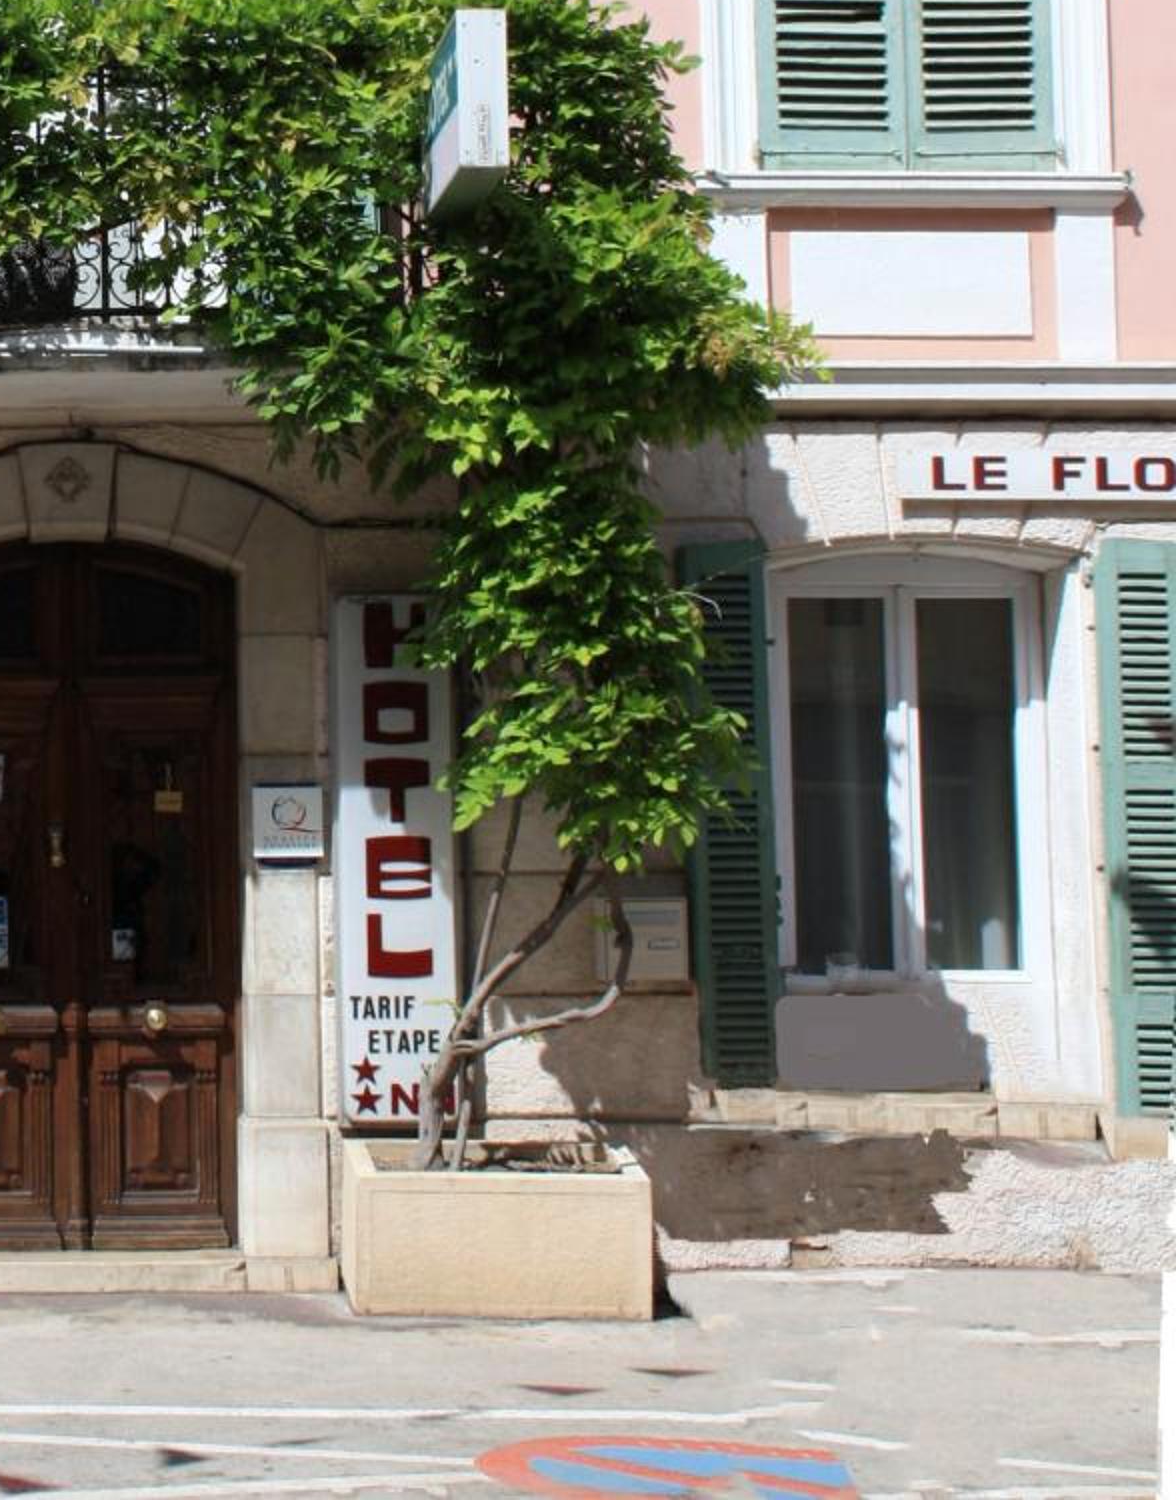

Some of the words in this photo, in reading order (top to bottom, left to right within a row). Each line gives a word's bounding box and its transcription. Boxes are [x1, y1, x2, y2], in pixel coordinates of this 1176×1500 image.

[932, 455, 1007, 492] LE
[1052, 455, 1176, 492] FLO
[363, 602, 433, 979] HOTEL
[349, 995, 416, 1020] TARIF
[368, 1029, 441, 1054] ETAPE
